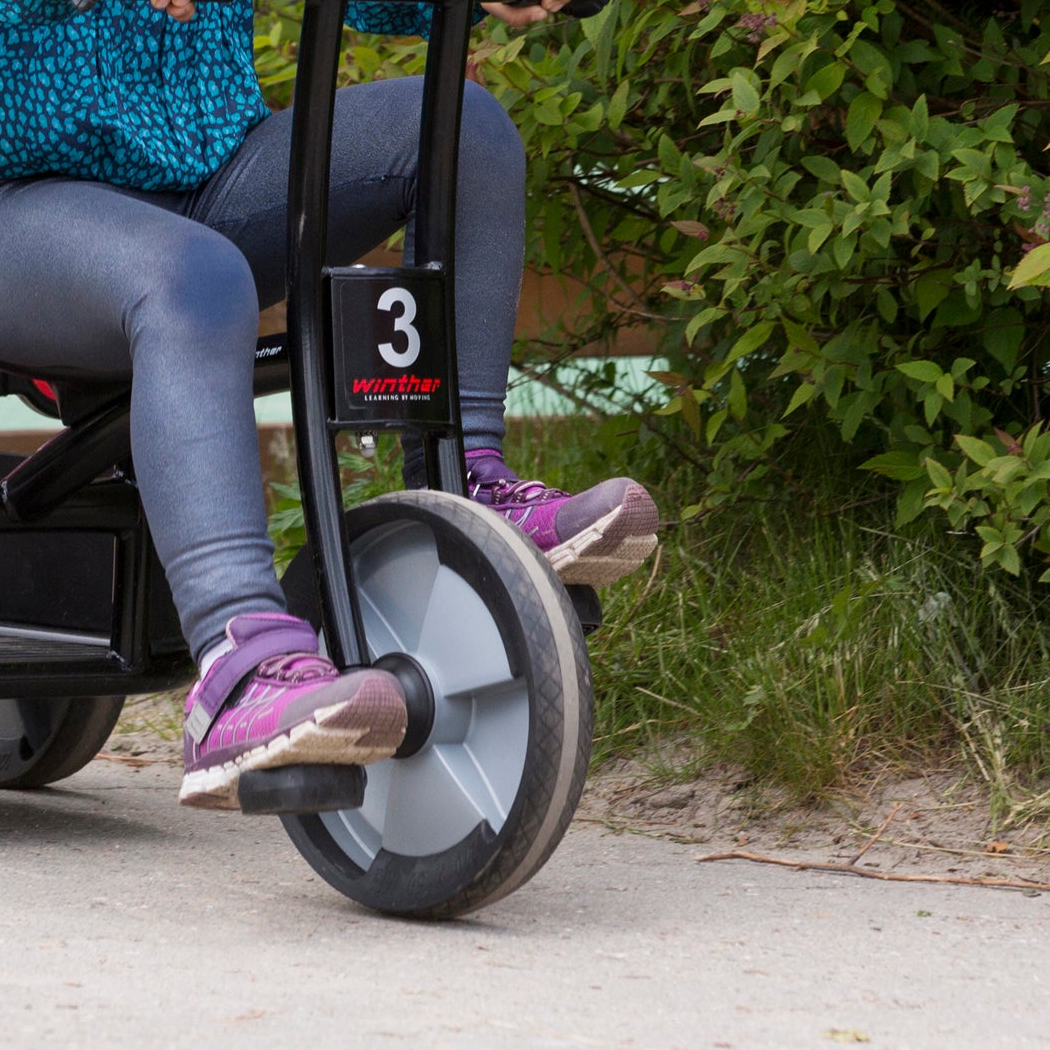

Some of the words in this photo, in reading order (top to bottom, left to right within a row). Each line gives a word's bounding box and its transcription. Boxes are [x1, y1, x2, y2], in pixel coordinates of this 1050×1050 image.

[377, 287, 421, 368] 3
[255, 346, 282, 358] nther
[353, 374, 441, 394] winther
